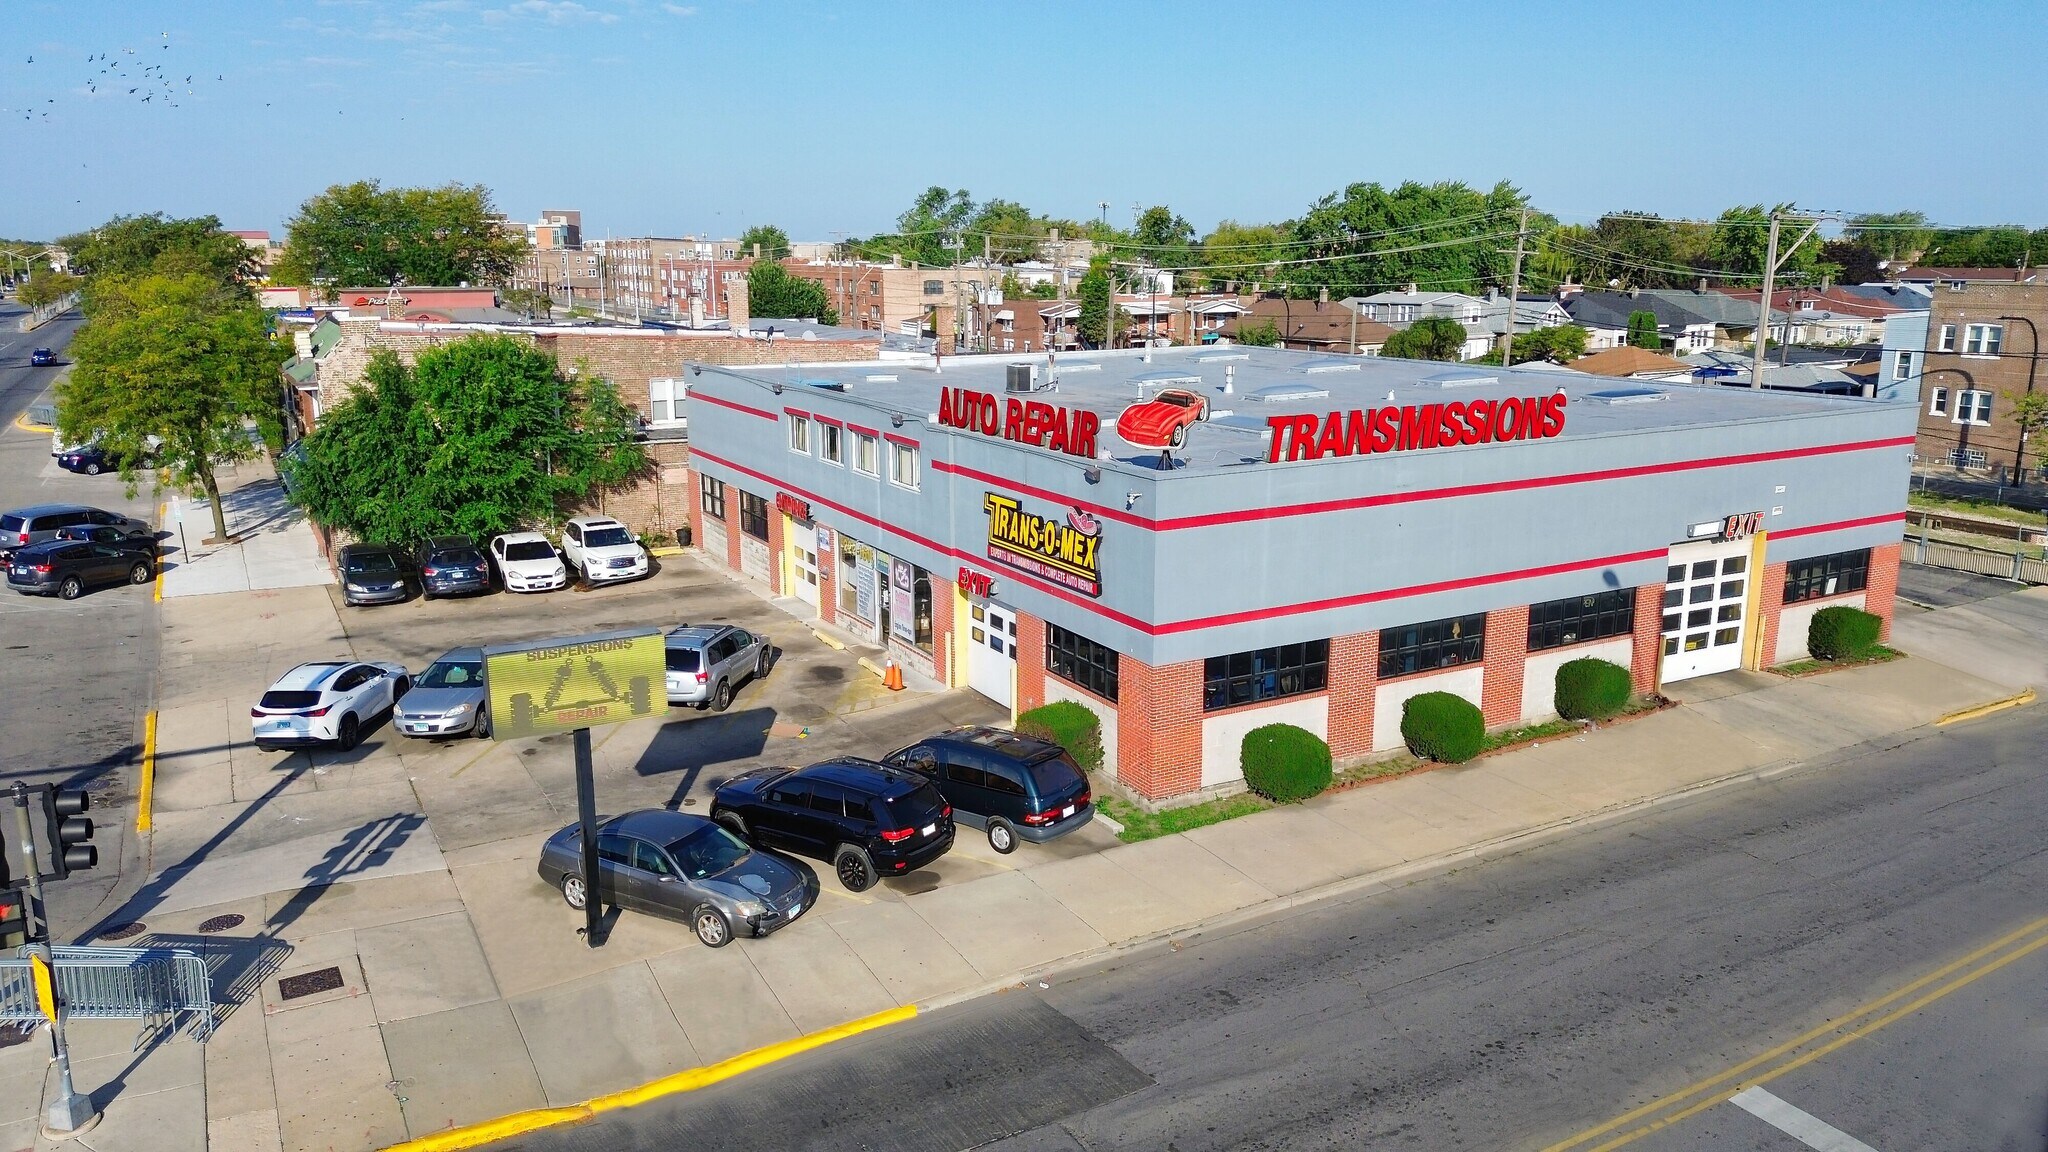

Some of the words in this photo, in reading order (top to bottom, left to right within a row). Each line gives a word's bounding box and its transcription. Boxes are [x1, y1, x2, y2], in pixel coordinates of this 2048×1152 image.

[938, 386, 998, 436] AUTO
[1004, 398, 1099, 459] REPAIR
[1266, 393, 1567, 463] TRANSMISSIONS
[989, 494, 1097, 570] TRANS-O-MEX
[1726, 511, 1765, 539] EXIT
[958, 566, 992, 599] EXIT
[526, 638, 633, 662] SUSPENSIONS
[557, 705, 608, 723] REPAIR
